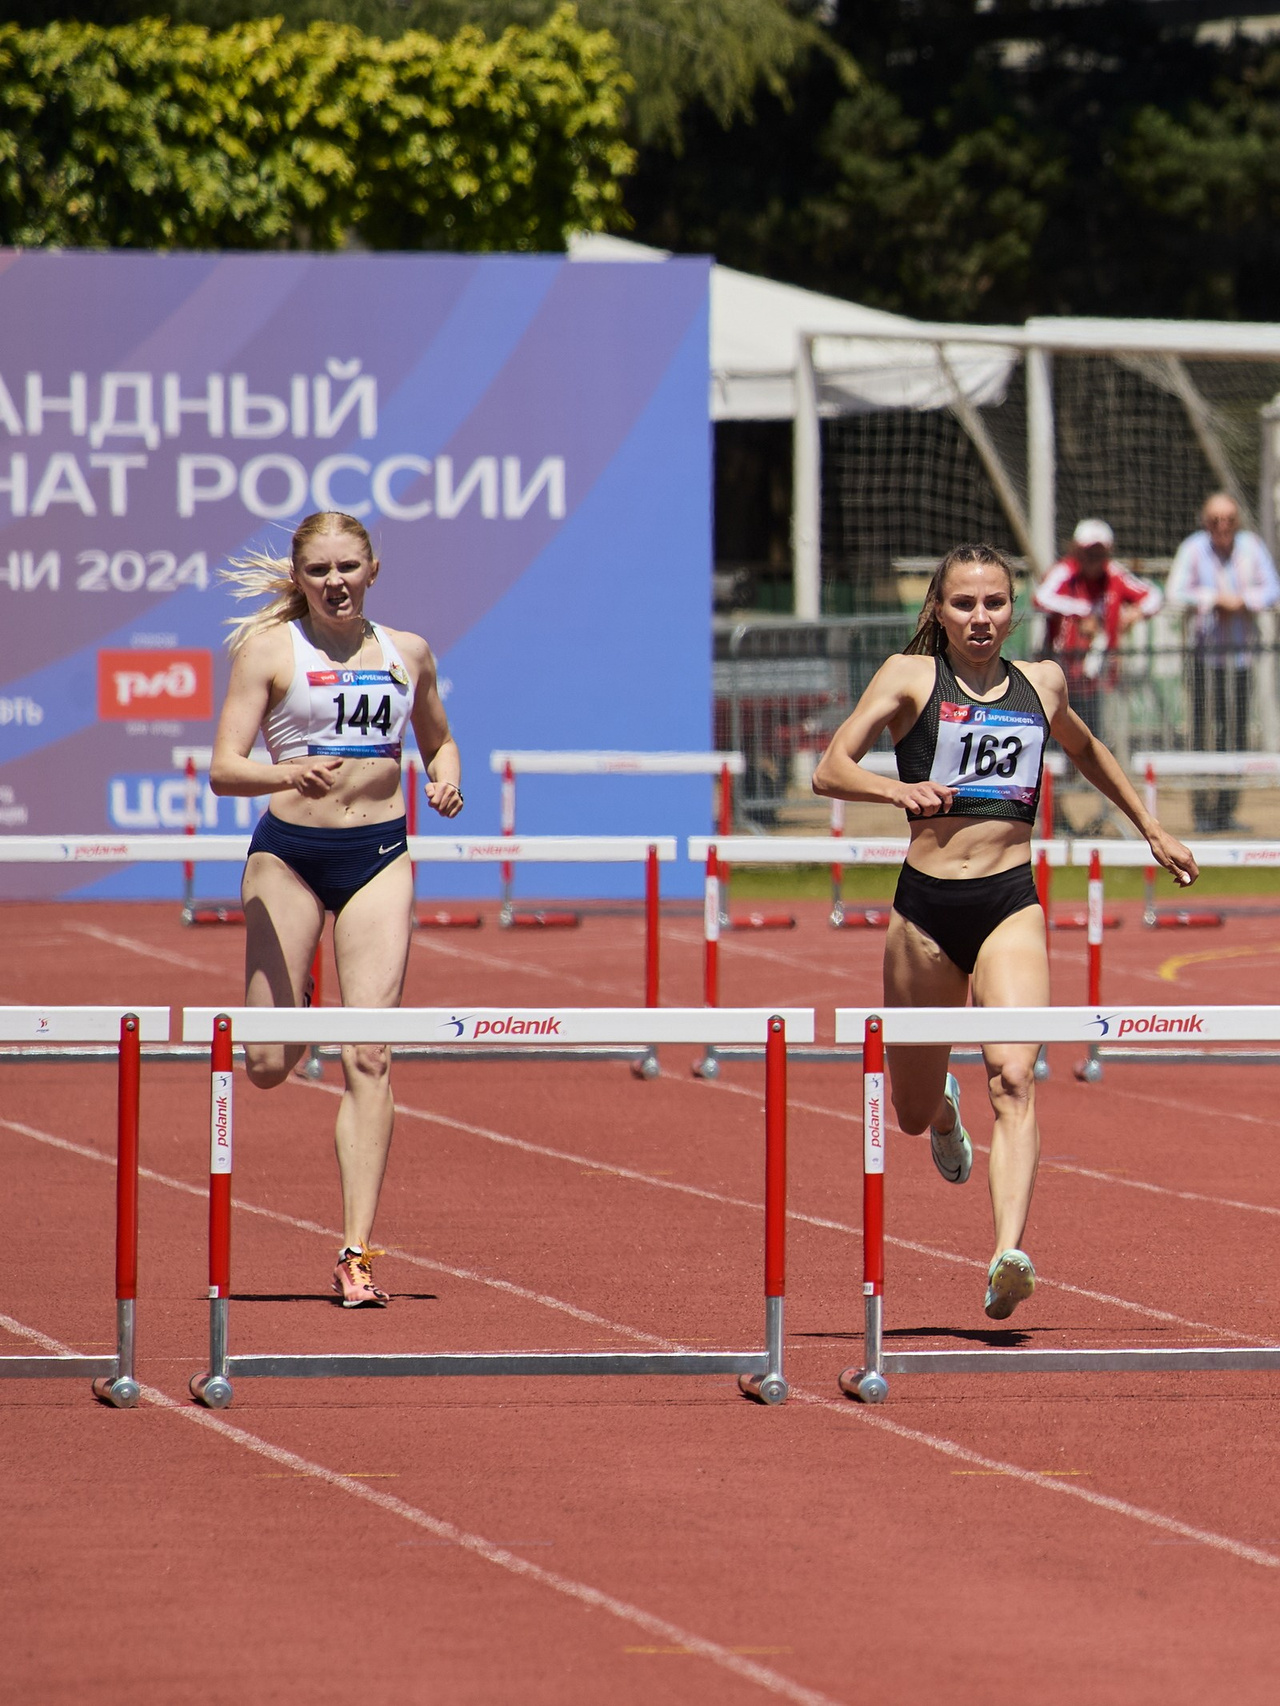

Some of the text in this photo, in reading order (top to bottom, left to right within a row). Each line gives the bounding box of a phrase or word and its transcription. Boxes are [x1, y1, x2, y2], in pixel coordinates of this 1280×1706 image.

[177, 453, 566, 521] РОССИИ
[76, 549, 209, 592] 2024
[333, 692, 391, 737] 144
[987, 713, 1035, 724] ЗАРУБЕЖНЕФТЬ
[958, 732, 1023, 779] 163
[473, 1016, 561, 1039] polanik
[1118, 1014, 1204, 1037] polanik
[216, 1096, 228, 1147] polanik
[869, 1098, 881, 1148] polanik
